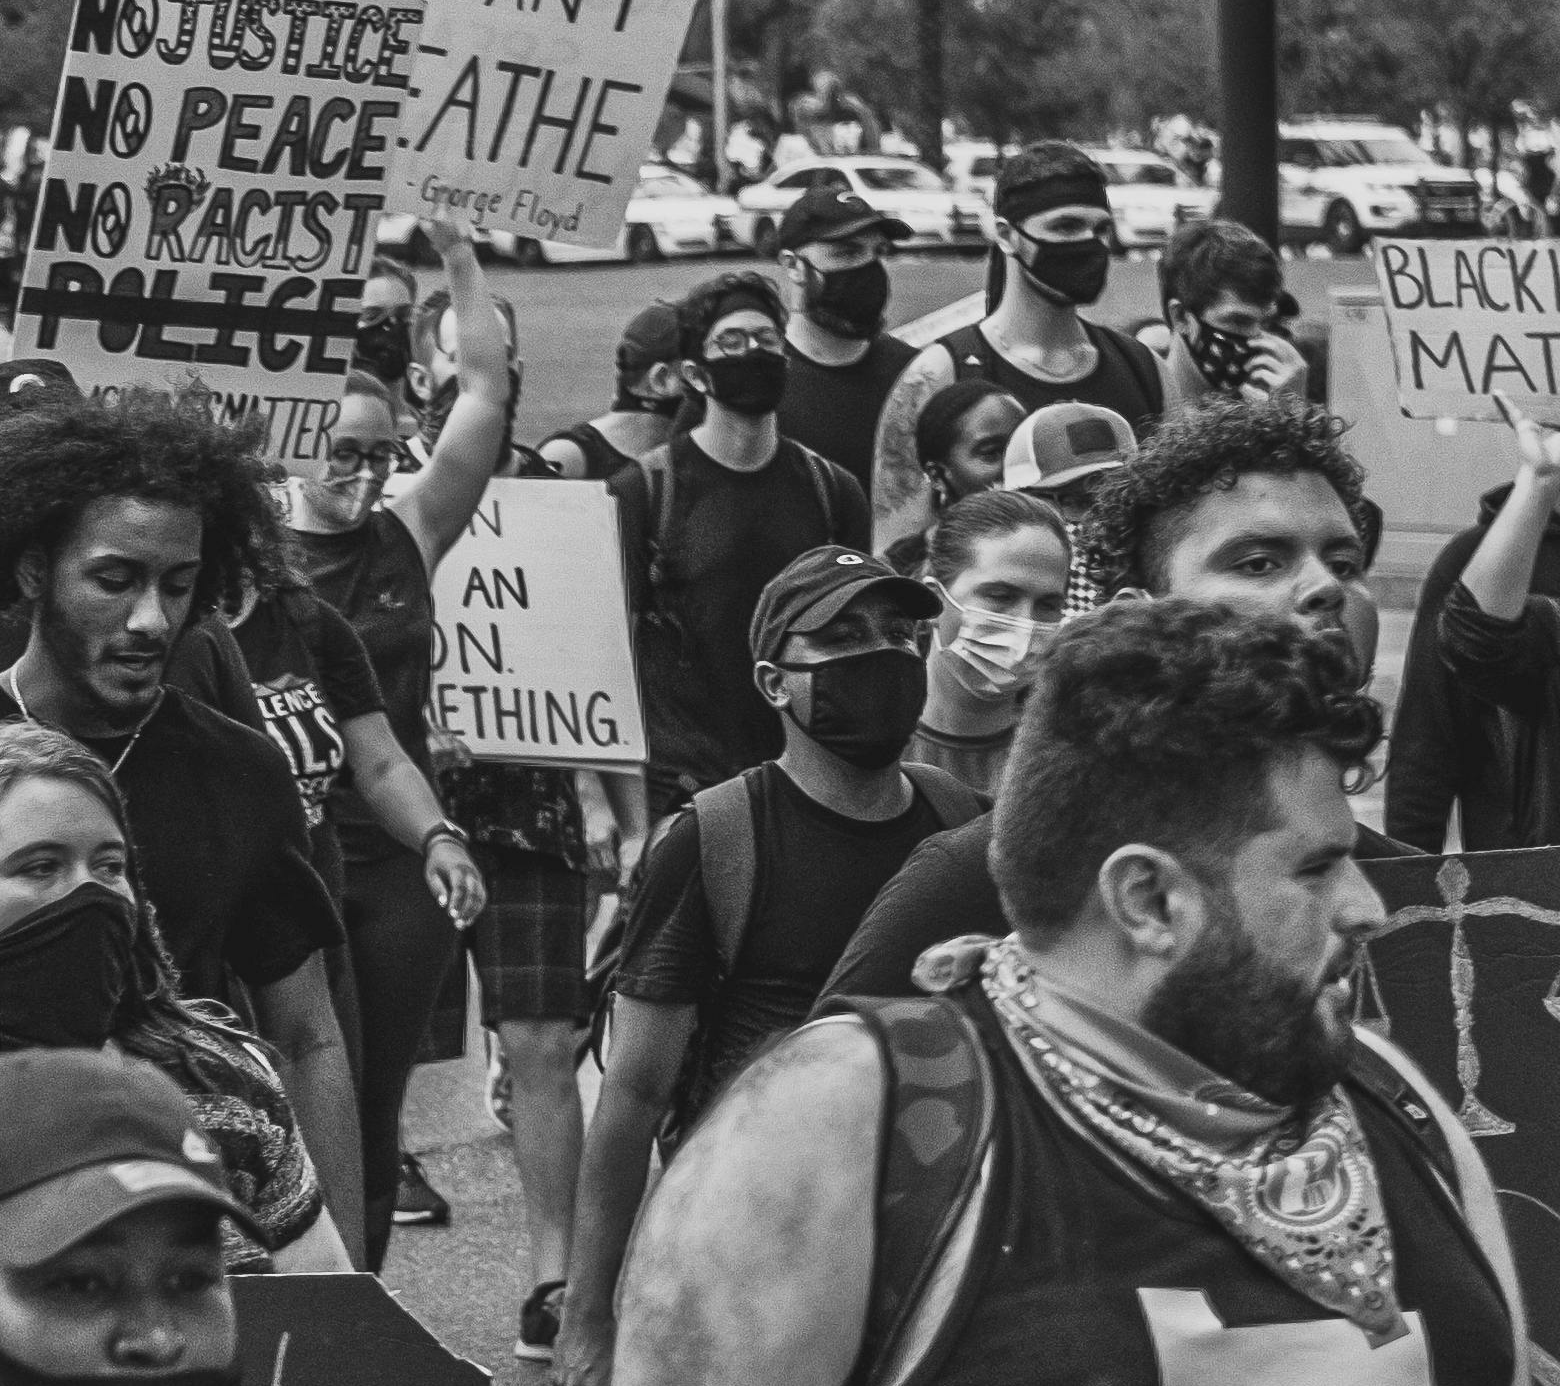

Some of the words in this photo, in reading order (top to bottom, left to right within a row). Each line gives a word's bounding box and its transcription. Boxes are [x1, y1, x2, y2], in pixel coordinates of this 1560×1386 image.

[54, 77, 152, 159] NO
[170, 87, 402, 181] PEACE
[36, 178, 132, 258] NO
[145, 162, 386, 275] RACIST
[511, 189, 584, 240] Floyd
[32, 261, 366, 376] POLICE
[257, 682, 325, 719] LENCE
[434, 683, 629, 748] ETHING.
